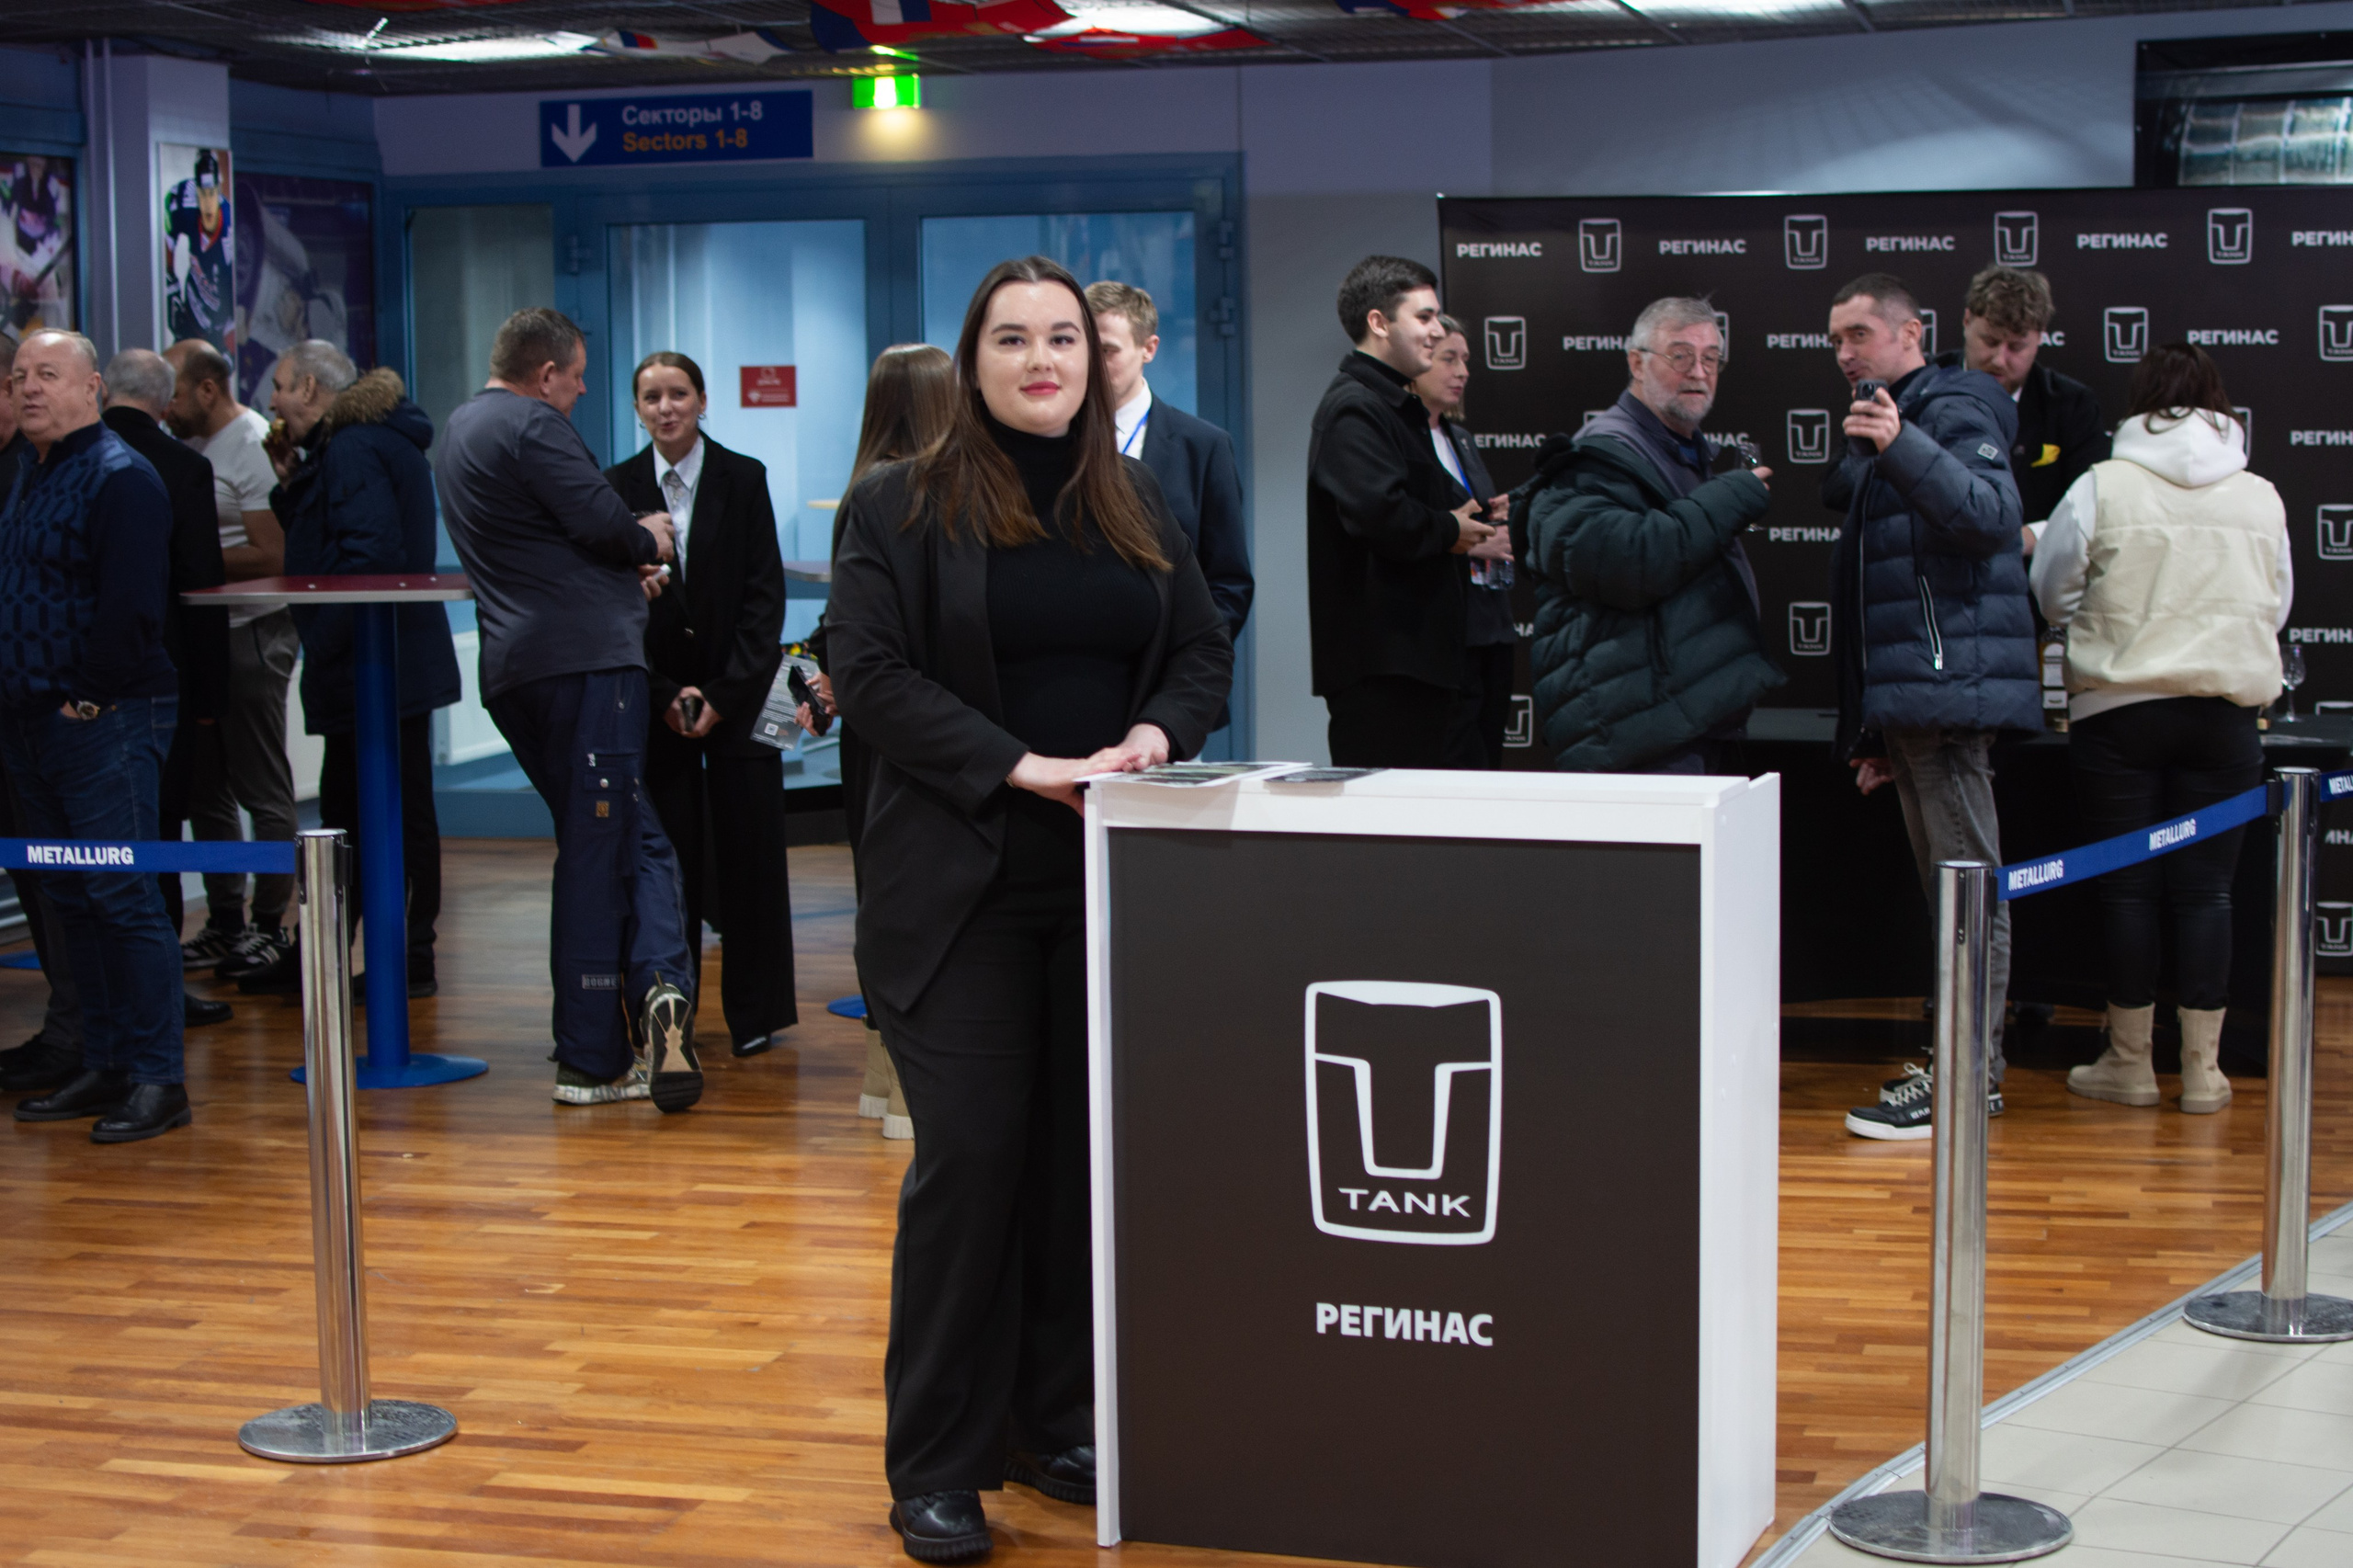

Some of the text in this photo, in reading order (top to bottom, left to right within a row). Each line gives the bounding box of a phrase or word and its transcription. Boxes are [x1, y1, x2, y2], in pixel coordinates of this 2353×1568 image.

[622, 100, 763, 127] Секторы 1-8
[622, 128, 748, 152] Sectors 1-8
[1866, 236, 1955, 251] РЕГИНАС
[2077, 233, 2168, 248] РЕГИНАС
[2291, 231, 2353, 246] РЕГИН
[1457, 242, 1541, 257] РЕГИНАС
[1659, 239, 1746, 255] РЕГИНАС
[1767, 334, 1834, 348] РЕГИН
[2188, 329, 2279, 345] РЕГИНАС
[1474, 433, 1546, 449] ЕГИНАС
[2290, 430, 2353, 446] РЕГИН
[1769, 527, 1842, 541] РЕГИНА
[2289, 628, 2353, 643] РЕГИН
[2149, 818, 2197, 851] METALLURG
[28, 846, 134, 865] METALLURG
[2008, 859, 2064, 891] METALLURG
[1338, 1187, 1471, 1217] TANK
[1316, 1302, 1493, 1346] РЕГИНАС
